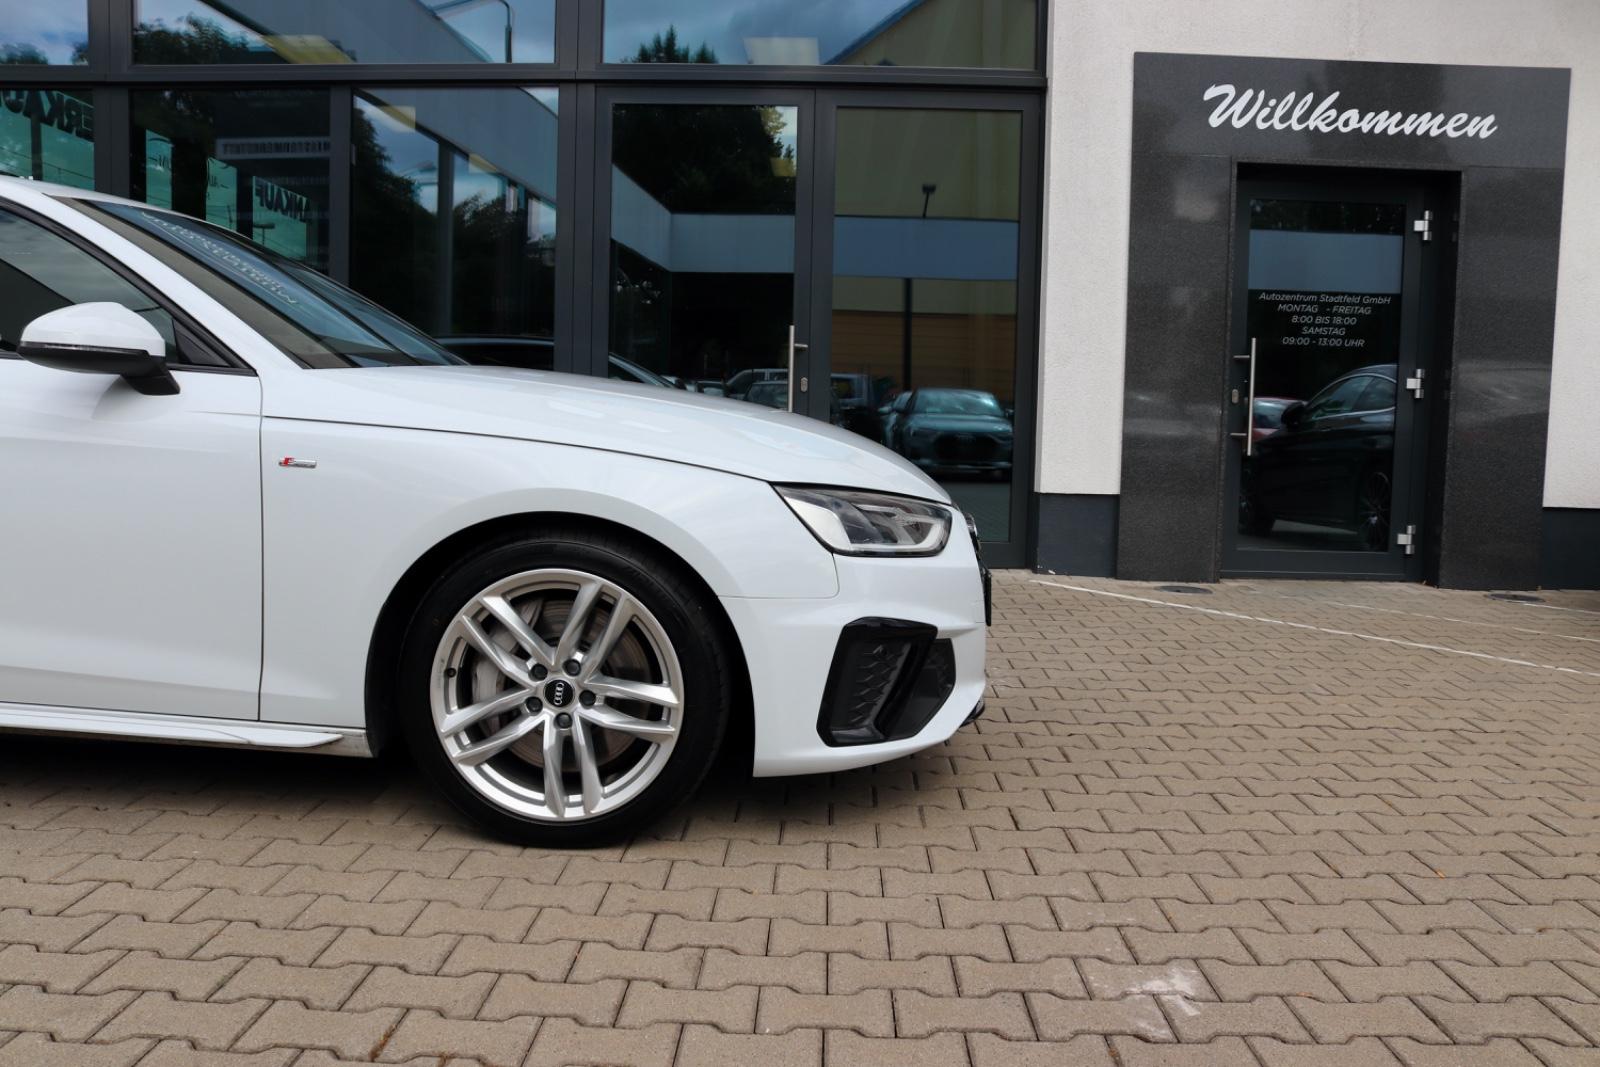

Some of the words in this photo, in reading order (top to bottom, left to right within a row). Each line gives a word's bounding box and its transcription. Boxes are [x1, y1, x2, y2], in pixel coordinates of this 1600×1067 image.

[1203, 83, 1498, 139] Willkommen
[1259, 292, 1317, 302] Autozentrum
[1320, 294, 1360, 303] Stadtfeld
[1362, 296, 1391, 304] GmbH
[1277, 304, 1318, 313] MONTAG
[1332, 305, 1372, 315] FREITAG
[1291, 315, 1313, 324] 8:00
[1315, 316, 1330, 324] BIS
[1332, 316, 1357, 325] 18:00
[1301, 326, 1346, 336] SAMSTAG
[1282, 336, 1310, 346] 09:00
[1318, 337, 1342, 347] 13:00
[1344, 338, 1365, 347] UHR
